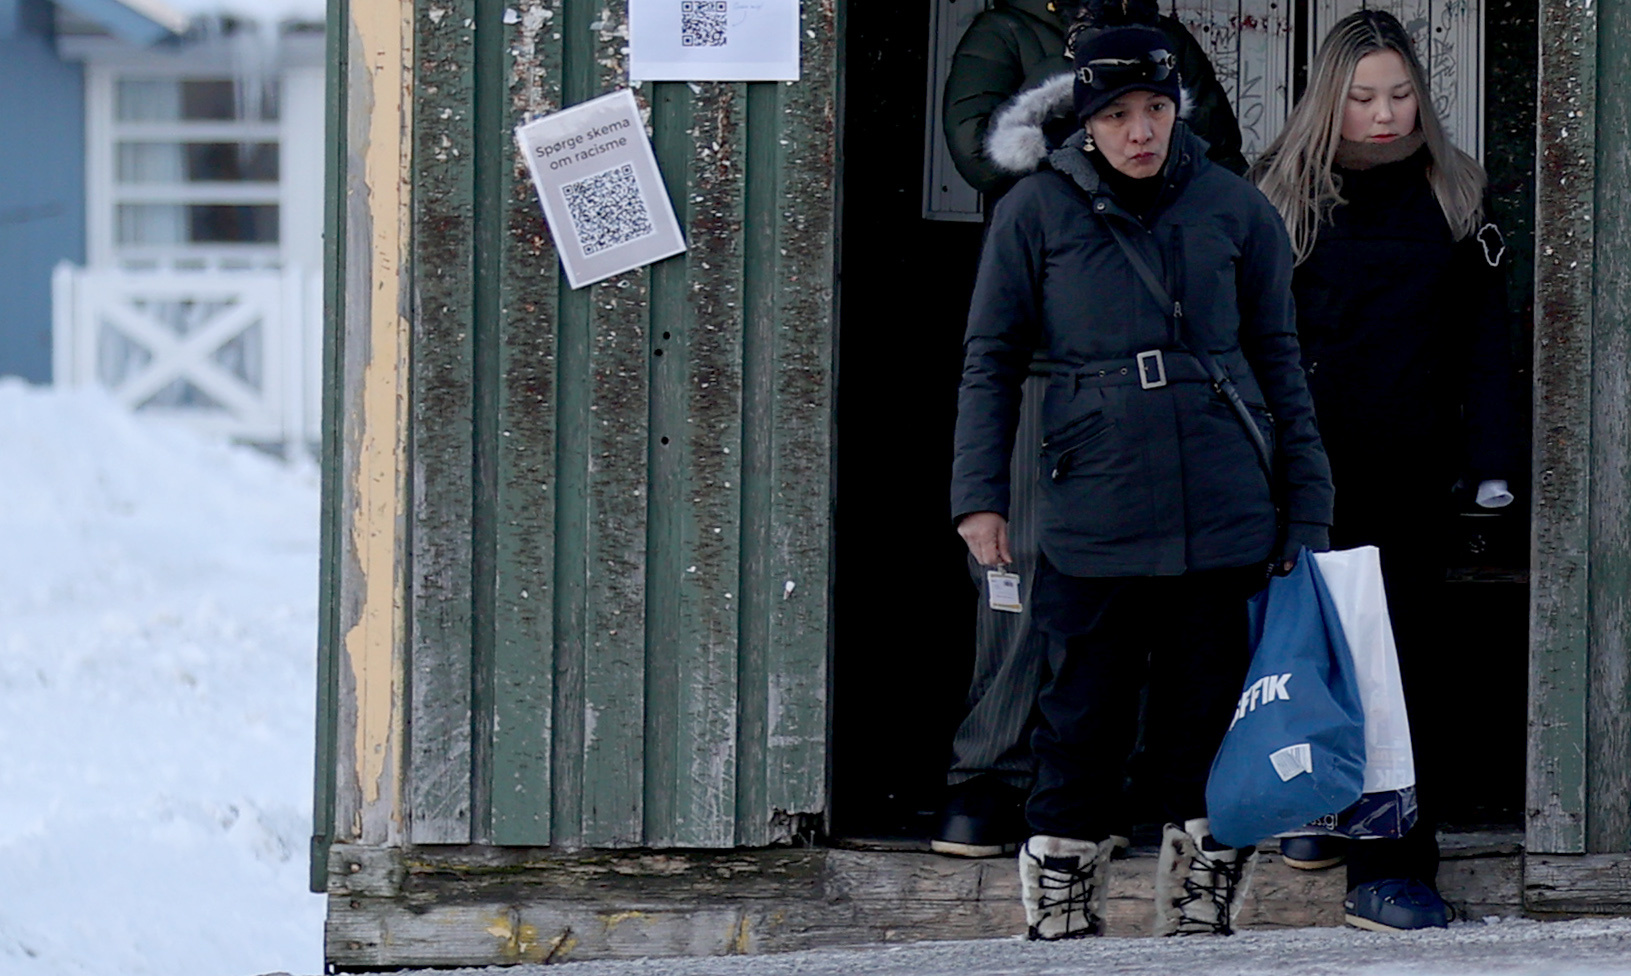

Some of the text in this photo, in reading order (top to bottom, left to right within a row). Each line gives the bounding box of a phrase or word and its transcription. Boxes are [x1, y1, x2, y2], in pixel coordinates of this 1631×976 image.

[535, 116, 631, 160] Spørge skema
[549, 135, 628, 172] om racisme
